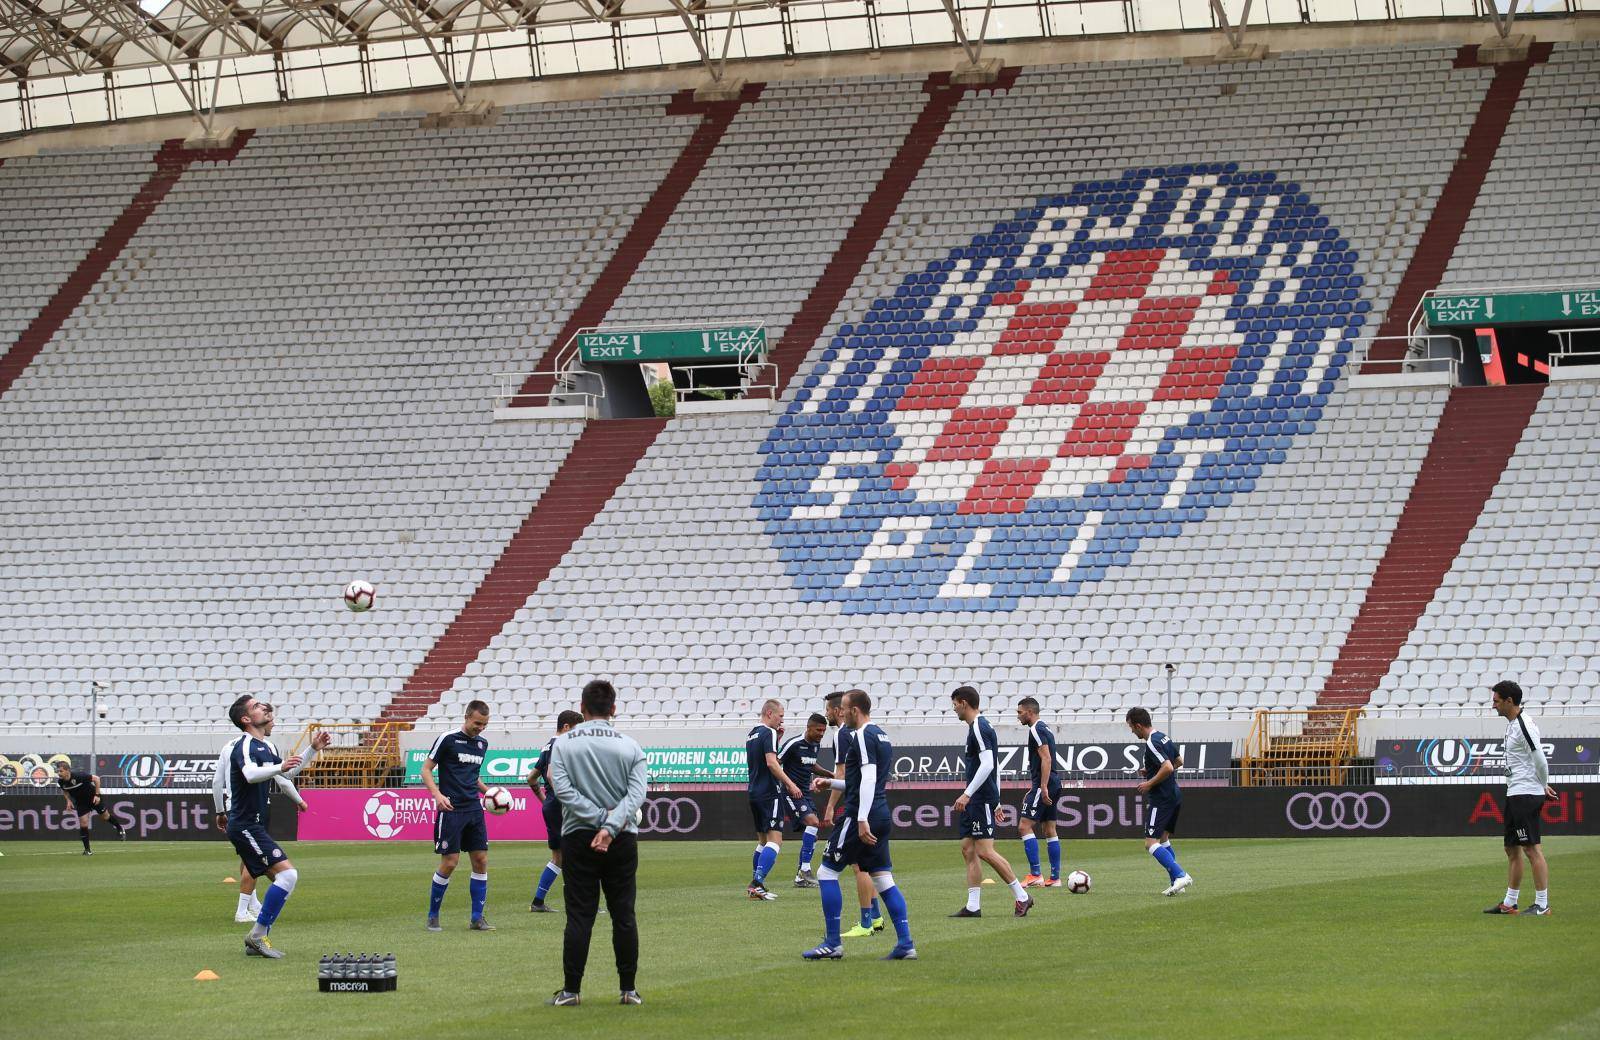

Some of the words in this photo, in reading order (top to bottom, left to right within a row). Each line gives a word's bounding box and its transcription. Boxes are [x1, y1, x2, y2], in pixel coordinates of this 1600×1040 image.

[1431, 297, 1480, 310] IZLAZ
[1574, 291, 1600, 304] IZL
[1437, 310, 1475, 322] EXIT
[584, 335, 629, 347] IZLAZ
[713, 329, 760, 342] IZLAZ
[590, 346, 625, 358] EXIT
[719, 341, 755, 353] EXIT
[568, 728, 624, 739] HAJDUK
[164, 759, 219, 772] ULTR
[1121, 744, 1207, 774] SLI
[646, 767, 691, 778] dulićeva
[894, 755, 966, 777] ORAN
[173, 774, 215, 783] EUROP
[396, 798, 437, 811] HRVAT
[1468, 790, 1585, 825] Adi
[0, 804, 98, 831] entar
[112, 800, 209, 838] Split
[395, 811, 428, 824] PRVA
[1056, 795, 1148, 836] Spli
[972, 820, 981, 831] 24
[329, 981, 369, 991] macron
